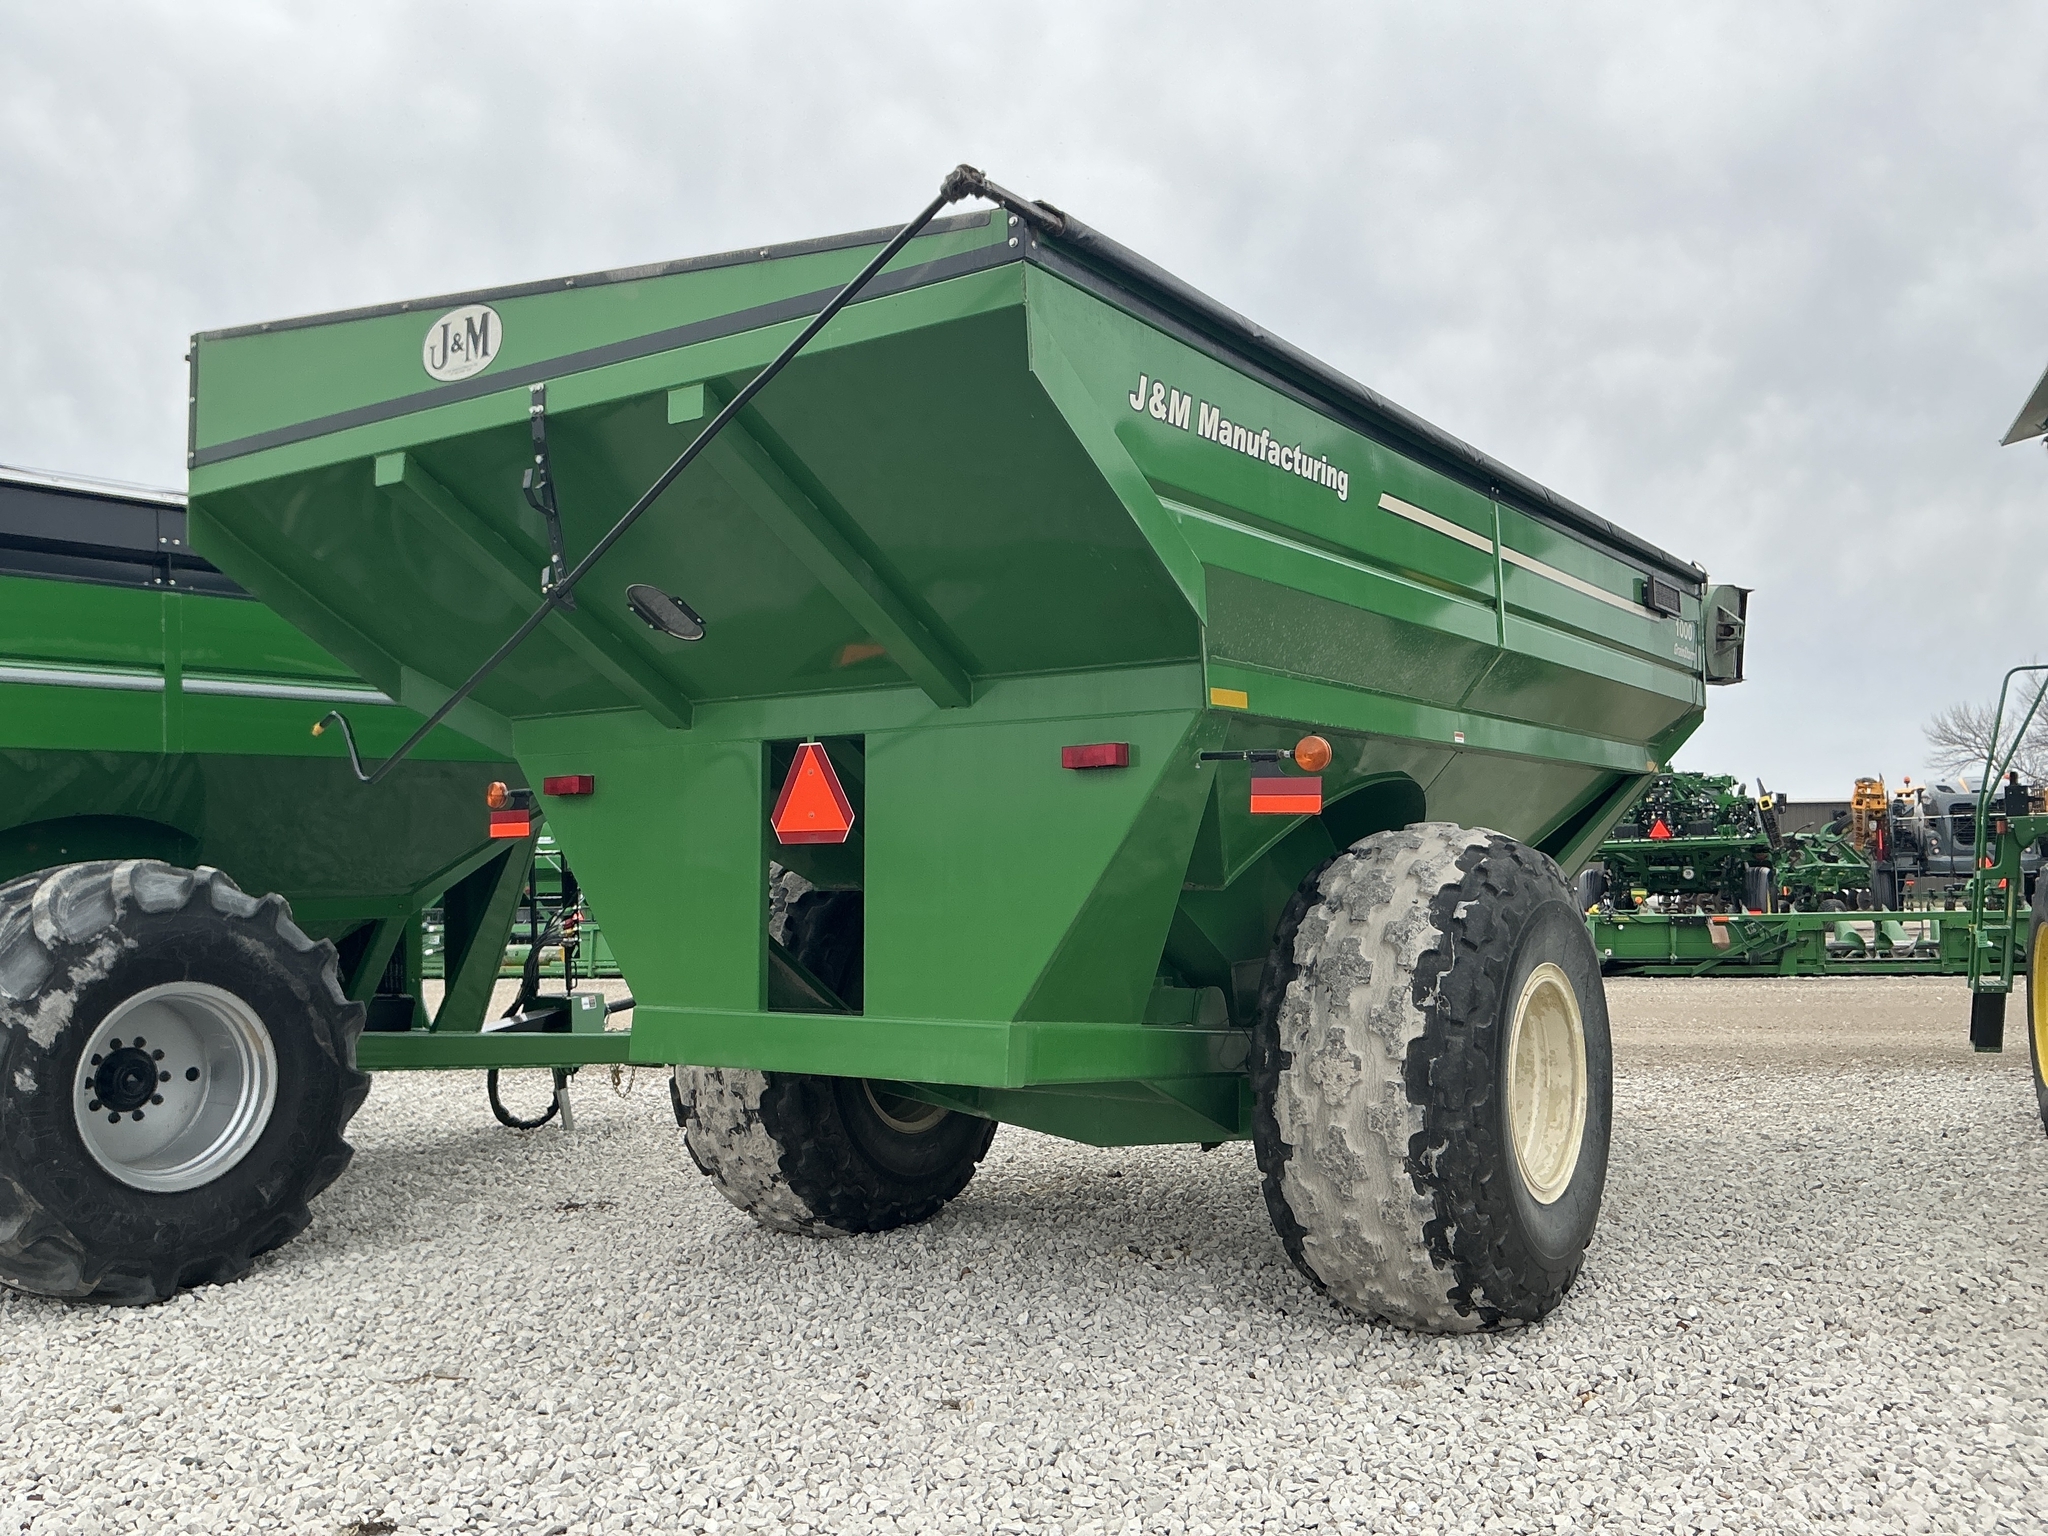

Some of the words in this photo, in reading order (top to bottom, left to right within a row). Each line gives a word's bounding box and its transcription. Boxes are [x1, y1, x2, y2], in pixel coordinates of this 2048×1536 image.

[429, 311, 491, 370] J&M
[1129, 373, 1192, 431] J&M
[1197, 399, 1349, 502] Manufacturing
[1675, 617, 1693, 642] 1000
